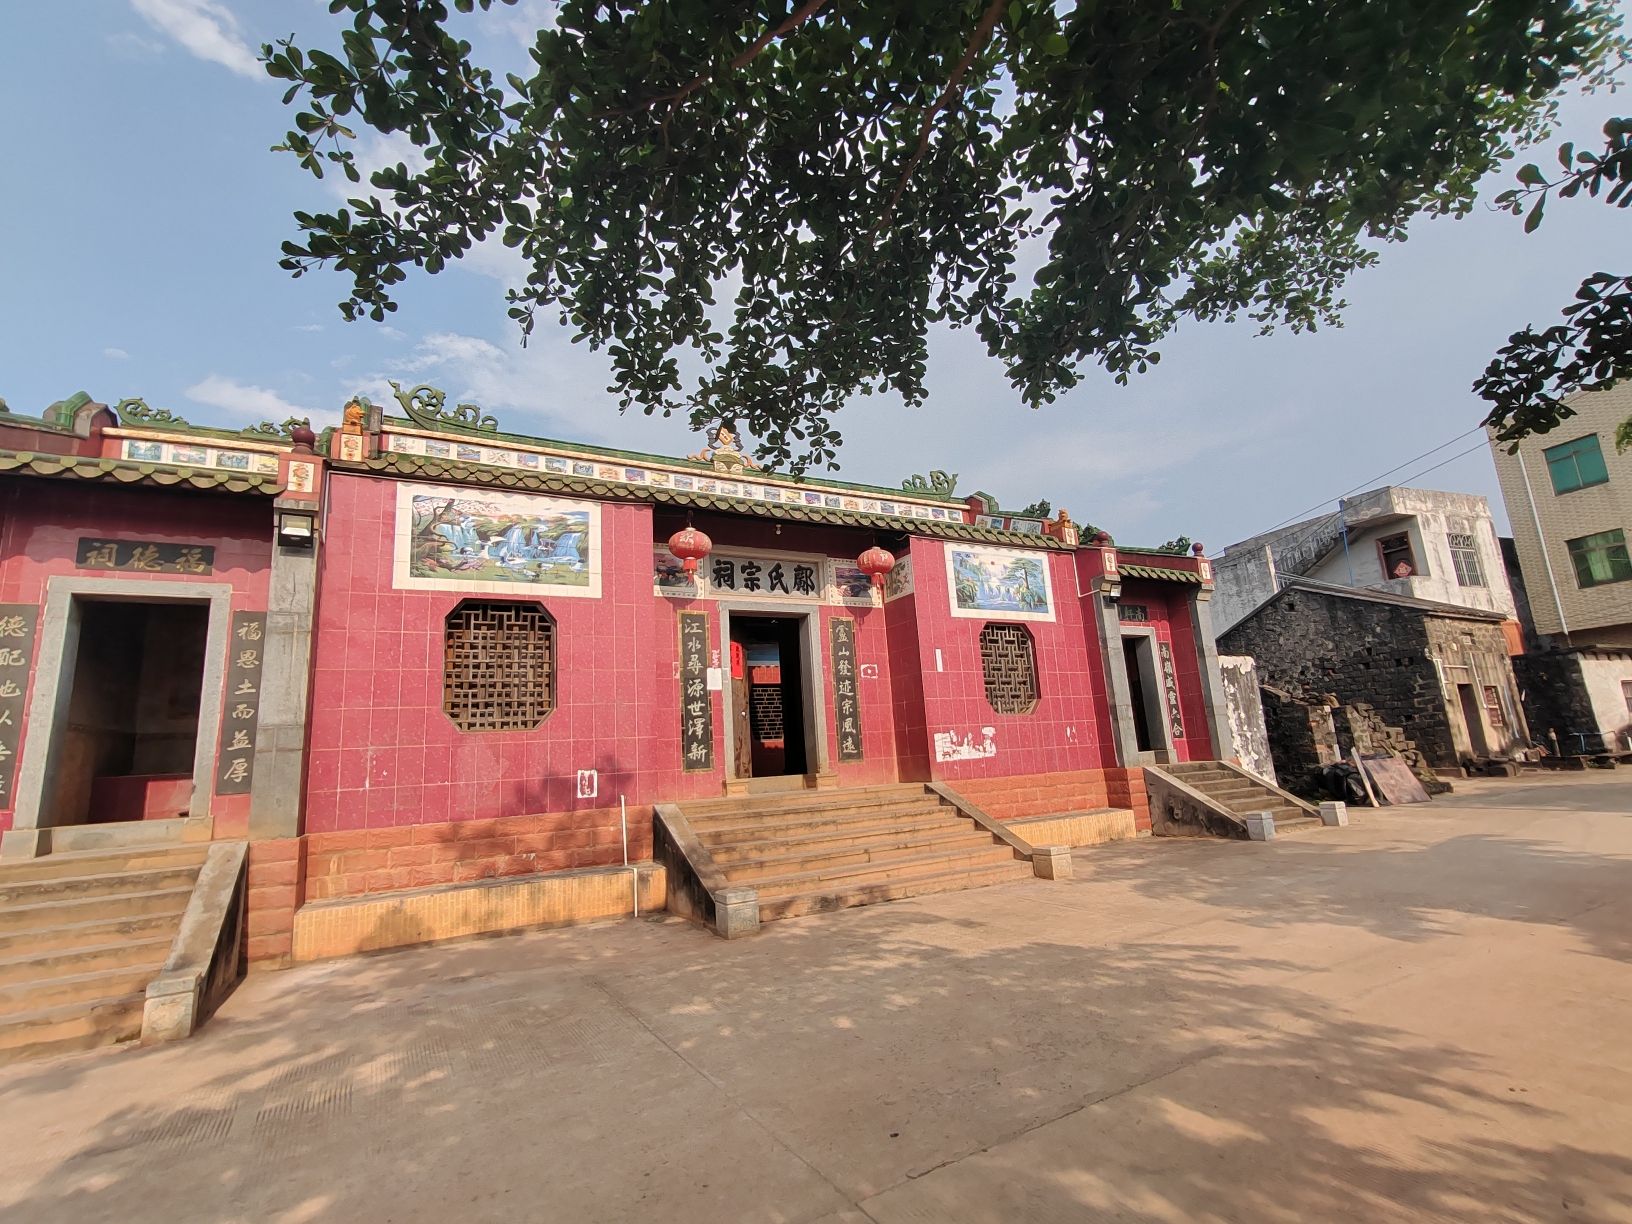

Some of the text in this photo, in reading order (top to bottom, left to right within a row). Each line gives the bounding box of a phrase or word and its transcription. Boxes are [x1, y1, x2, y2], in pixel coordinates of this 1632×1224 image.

[223, 622, 262, 783] 福恩土而益厚
